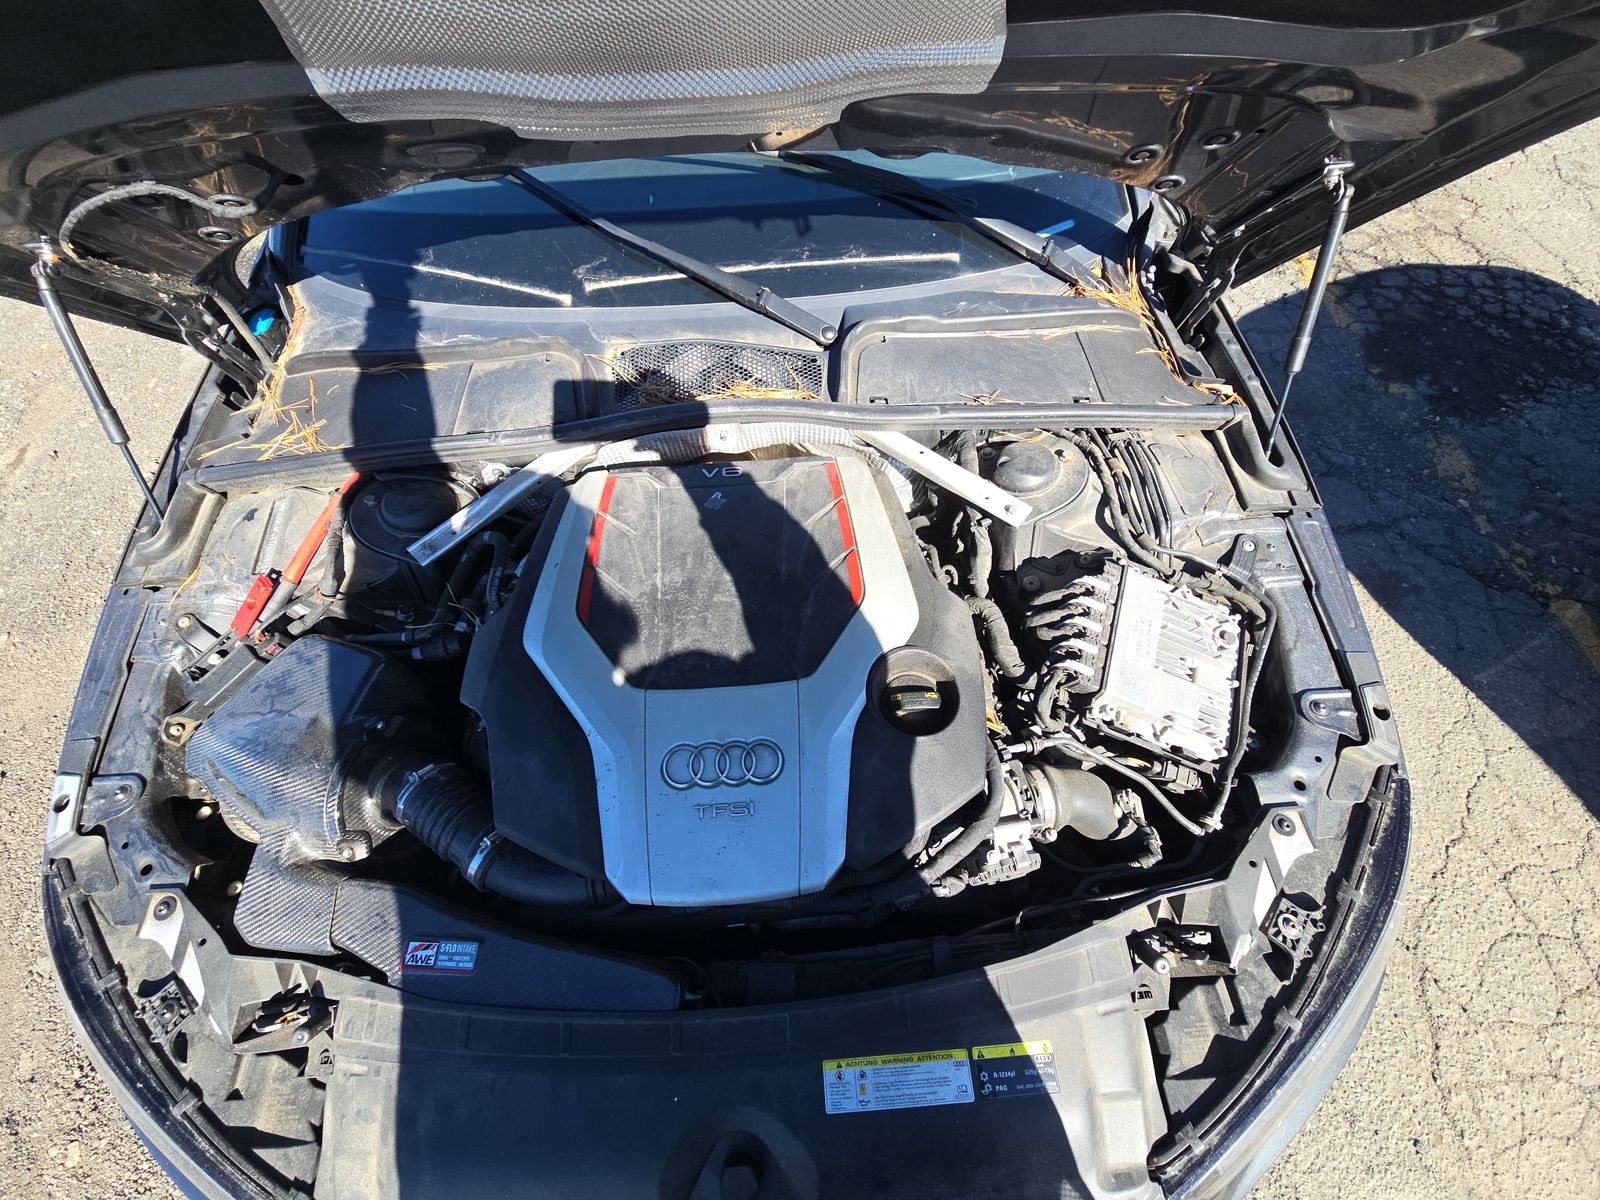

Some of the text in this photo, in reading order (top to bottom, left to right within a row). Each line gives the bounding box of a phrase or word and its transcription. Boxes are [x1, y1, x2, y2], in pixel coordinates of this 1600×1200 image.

[701, 466, 743, 478] V6
[693, 801, 755, 818] TFSI
[457, 944, 476, 954] INTAKE
[406, 954, 435, 965] AWE
[845, 1053, 953, 1068] ACHTUNG WARNING ATTENTION
[993, 1070, 1016, 1078] R-1234yf
